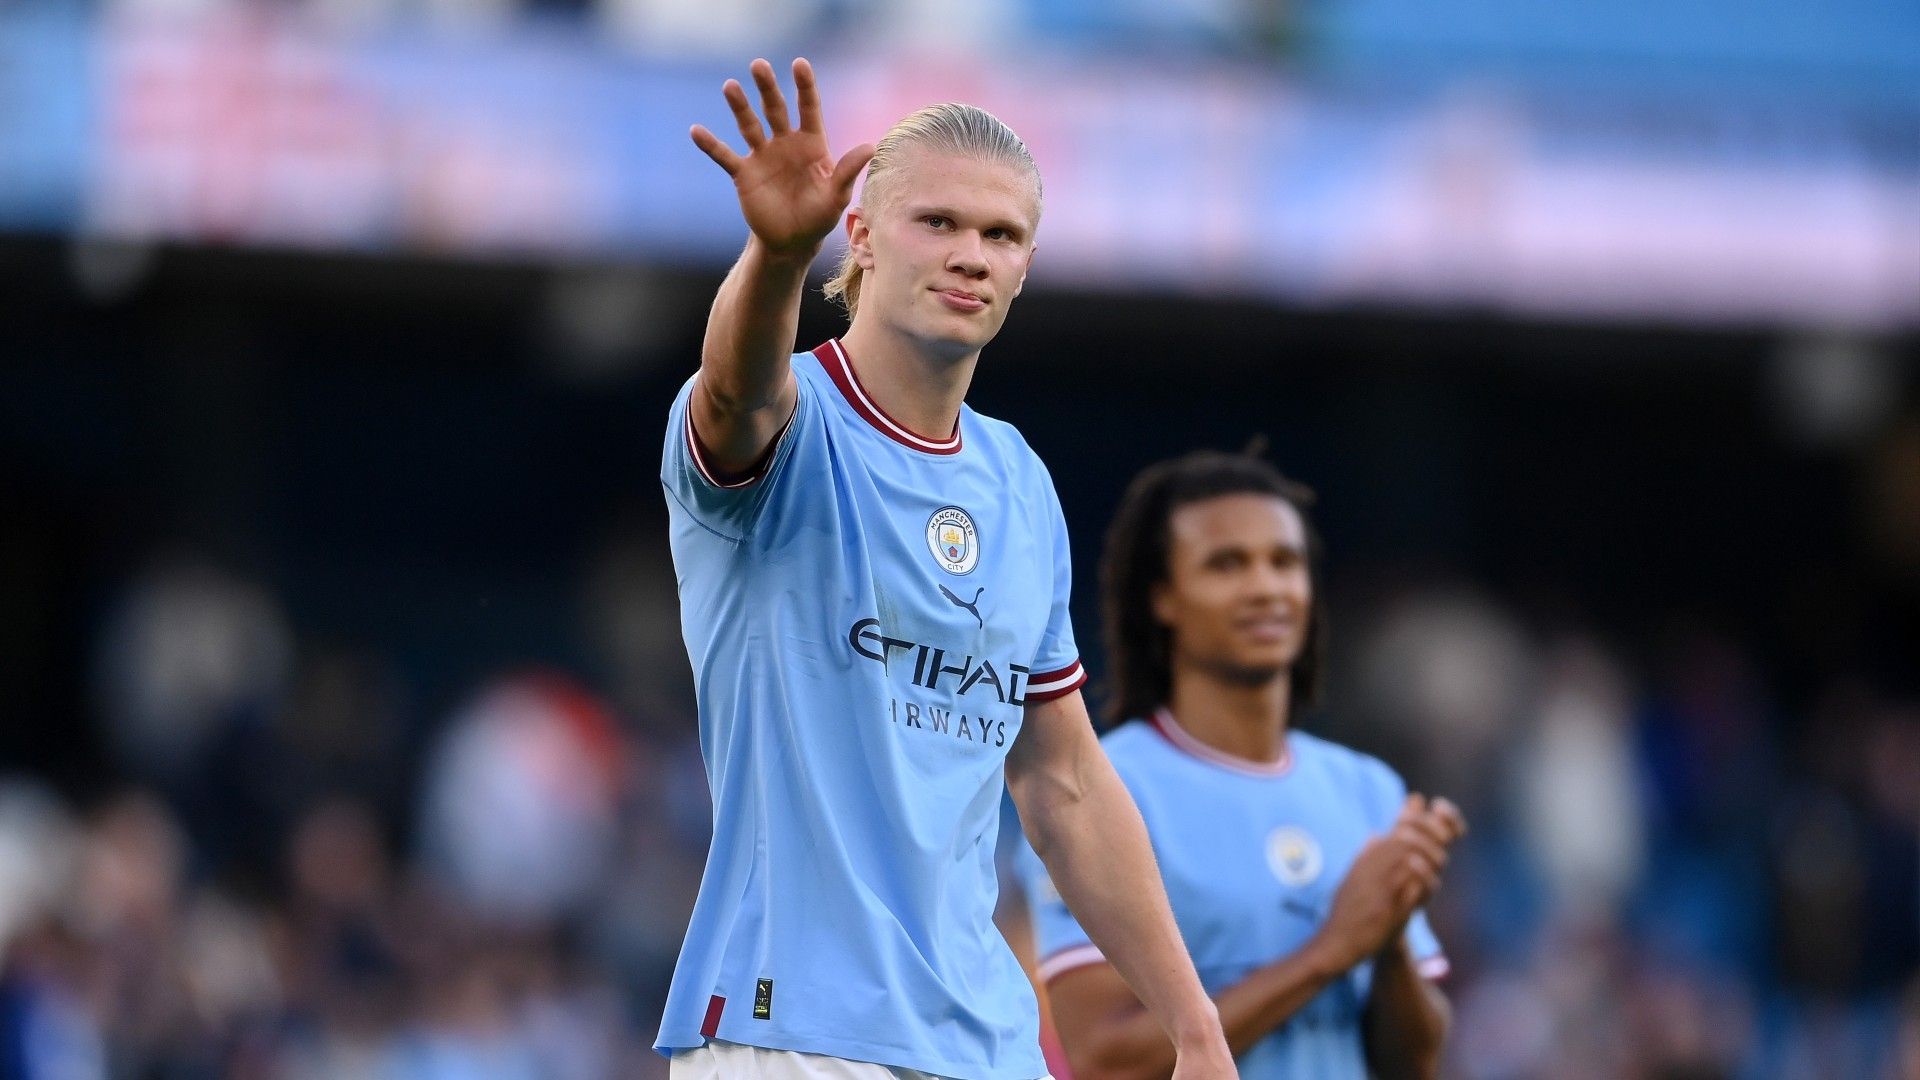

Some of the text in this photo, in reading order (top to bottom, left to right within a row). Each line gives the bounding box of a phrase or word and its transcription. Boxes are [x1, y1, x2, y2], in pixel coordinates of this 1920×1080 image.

[931, 511, 973, 536] MANCHESTER
[947, 563, 964, 571] CITY
[889, 698, 1005, 747] IRWAYS
